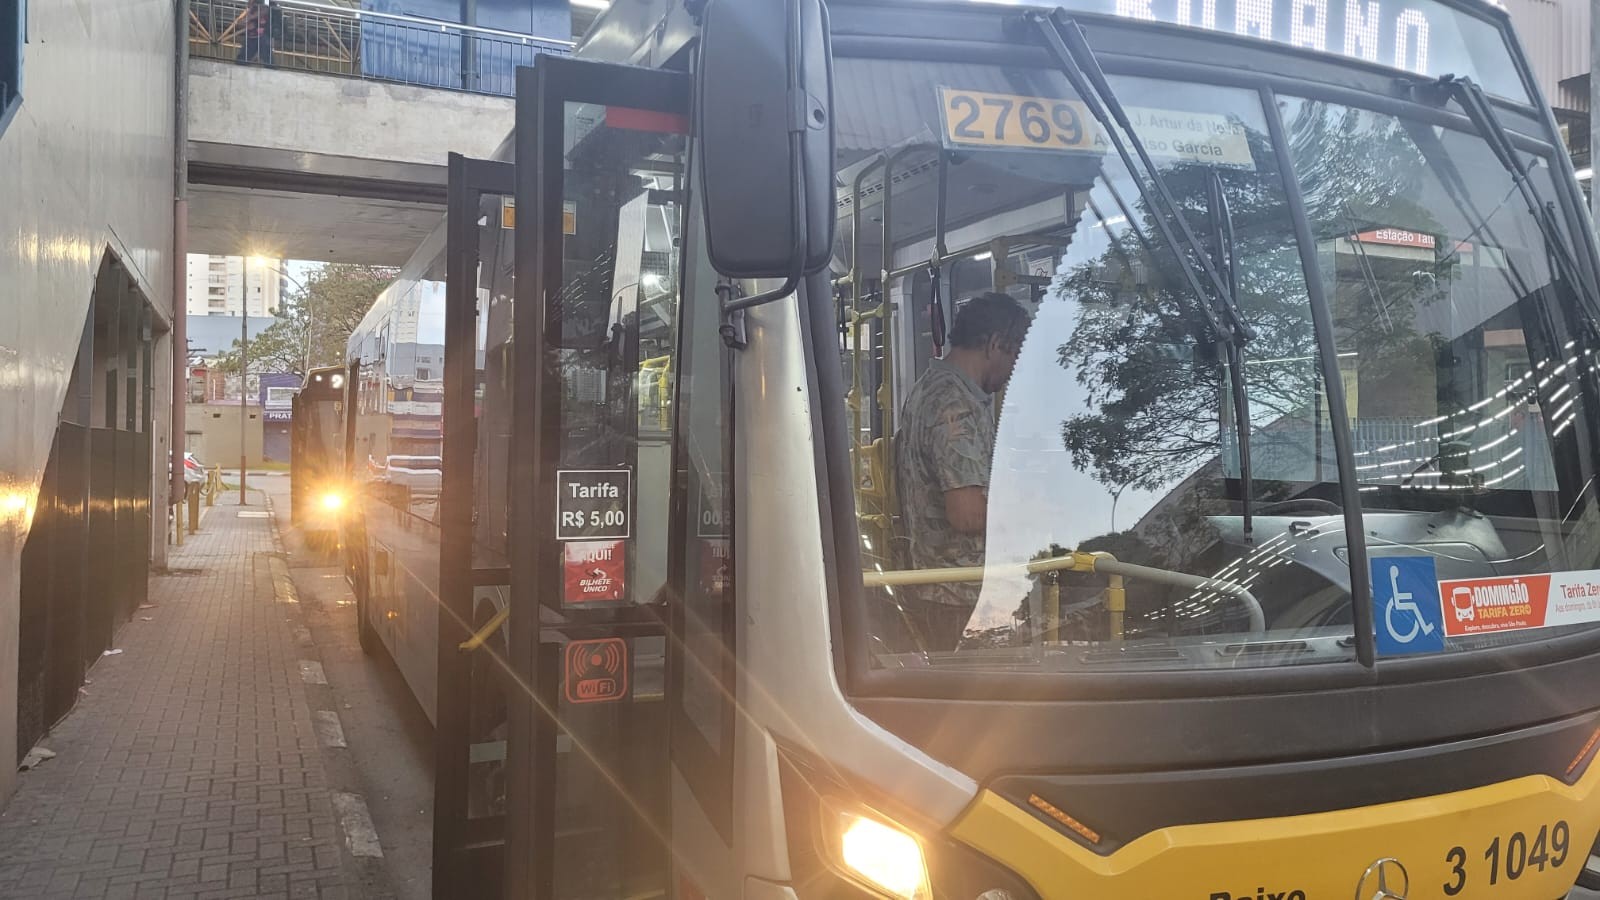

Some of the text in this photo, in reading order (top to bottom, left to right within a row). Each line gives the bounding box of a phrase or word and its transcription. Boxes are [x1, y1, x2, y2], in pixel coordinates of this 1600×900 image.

[950, 95, 1083, 146] 2769
[1151, 114, 1182, 130] Artur
[1126, 136, 1168, 152] Clso
[1172, 138, 1223, 157] Garcia
[1376, 229, 1413, 243] Estação
[568, 482, 619, 498] Tarifa
[562, 510, 625, 529] R$ 5,00
[579, 578, 612, 586] BILHETE
[1474, 579, 1529, 607] DOMINGÃO
[1559, 583, 1586, 599] Tarifa
[1478, 603, 1532, 619] TARIFA ZERO
[1442, 820, 1570, 897] 3 1049
